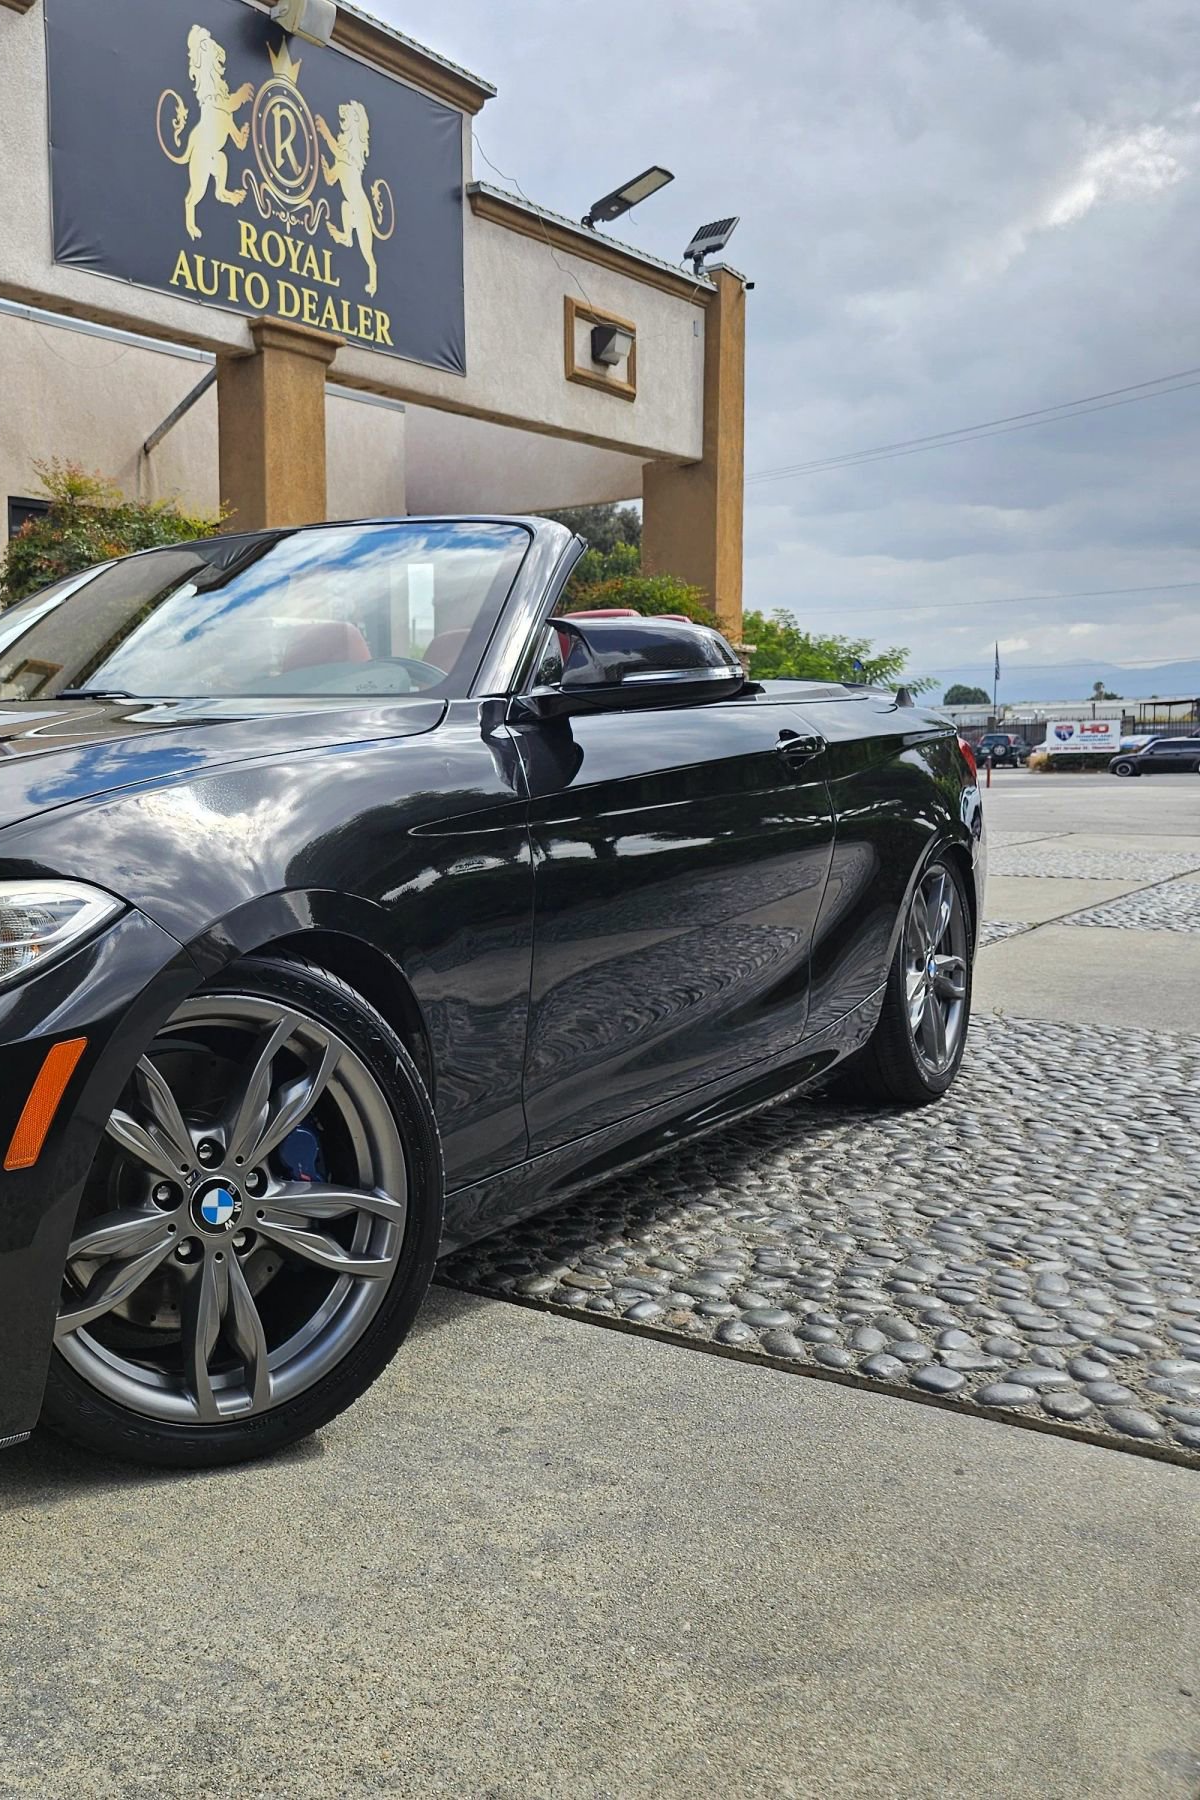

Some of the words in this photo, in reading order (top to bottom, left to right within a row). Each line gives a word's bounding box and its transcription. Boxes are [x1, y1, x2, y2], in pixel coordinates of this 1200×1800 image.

[237, 219, 341, 288] ROYAL
[169, 249, 270, 310] AUTO
[276, 279, 394, 347] DEALER
